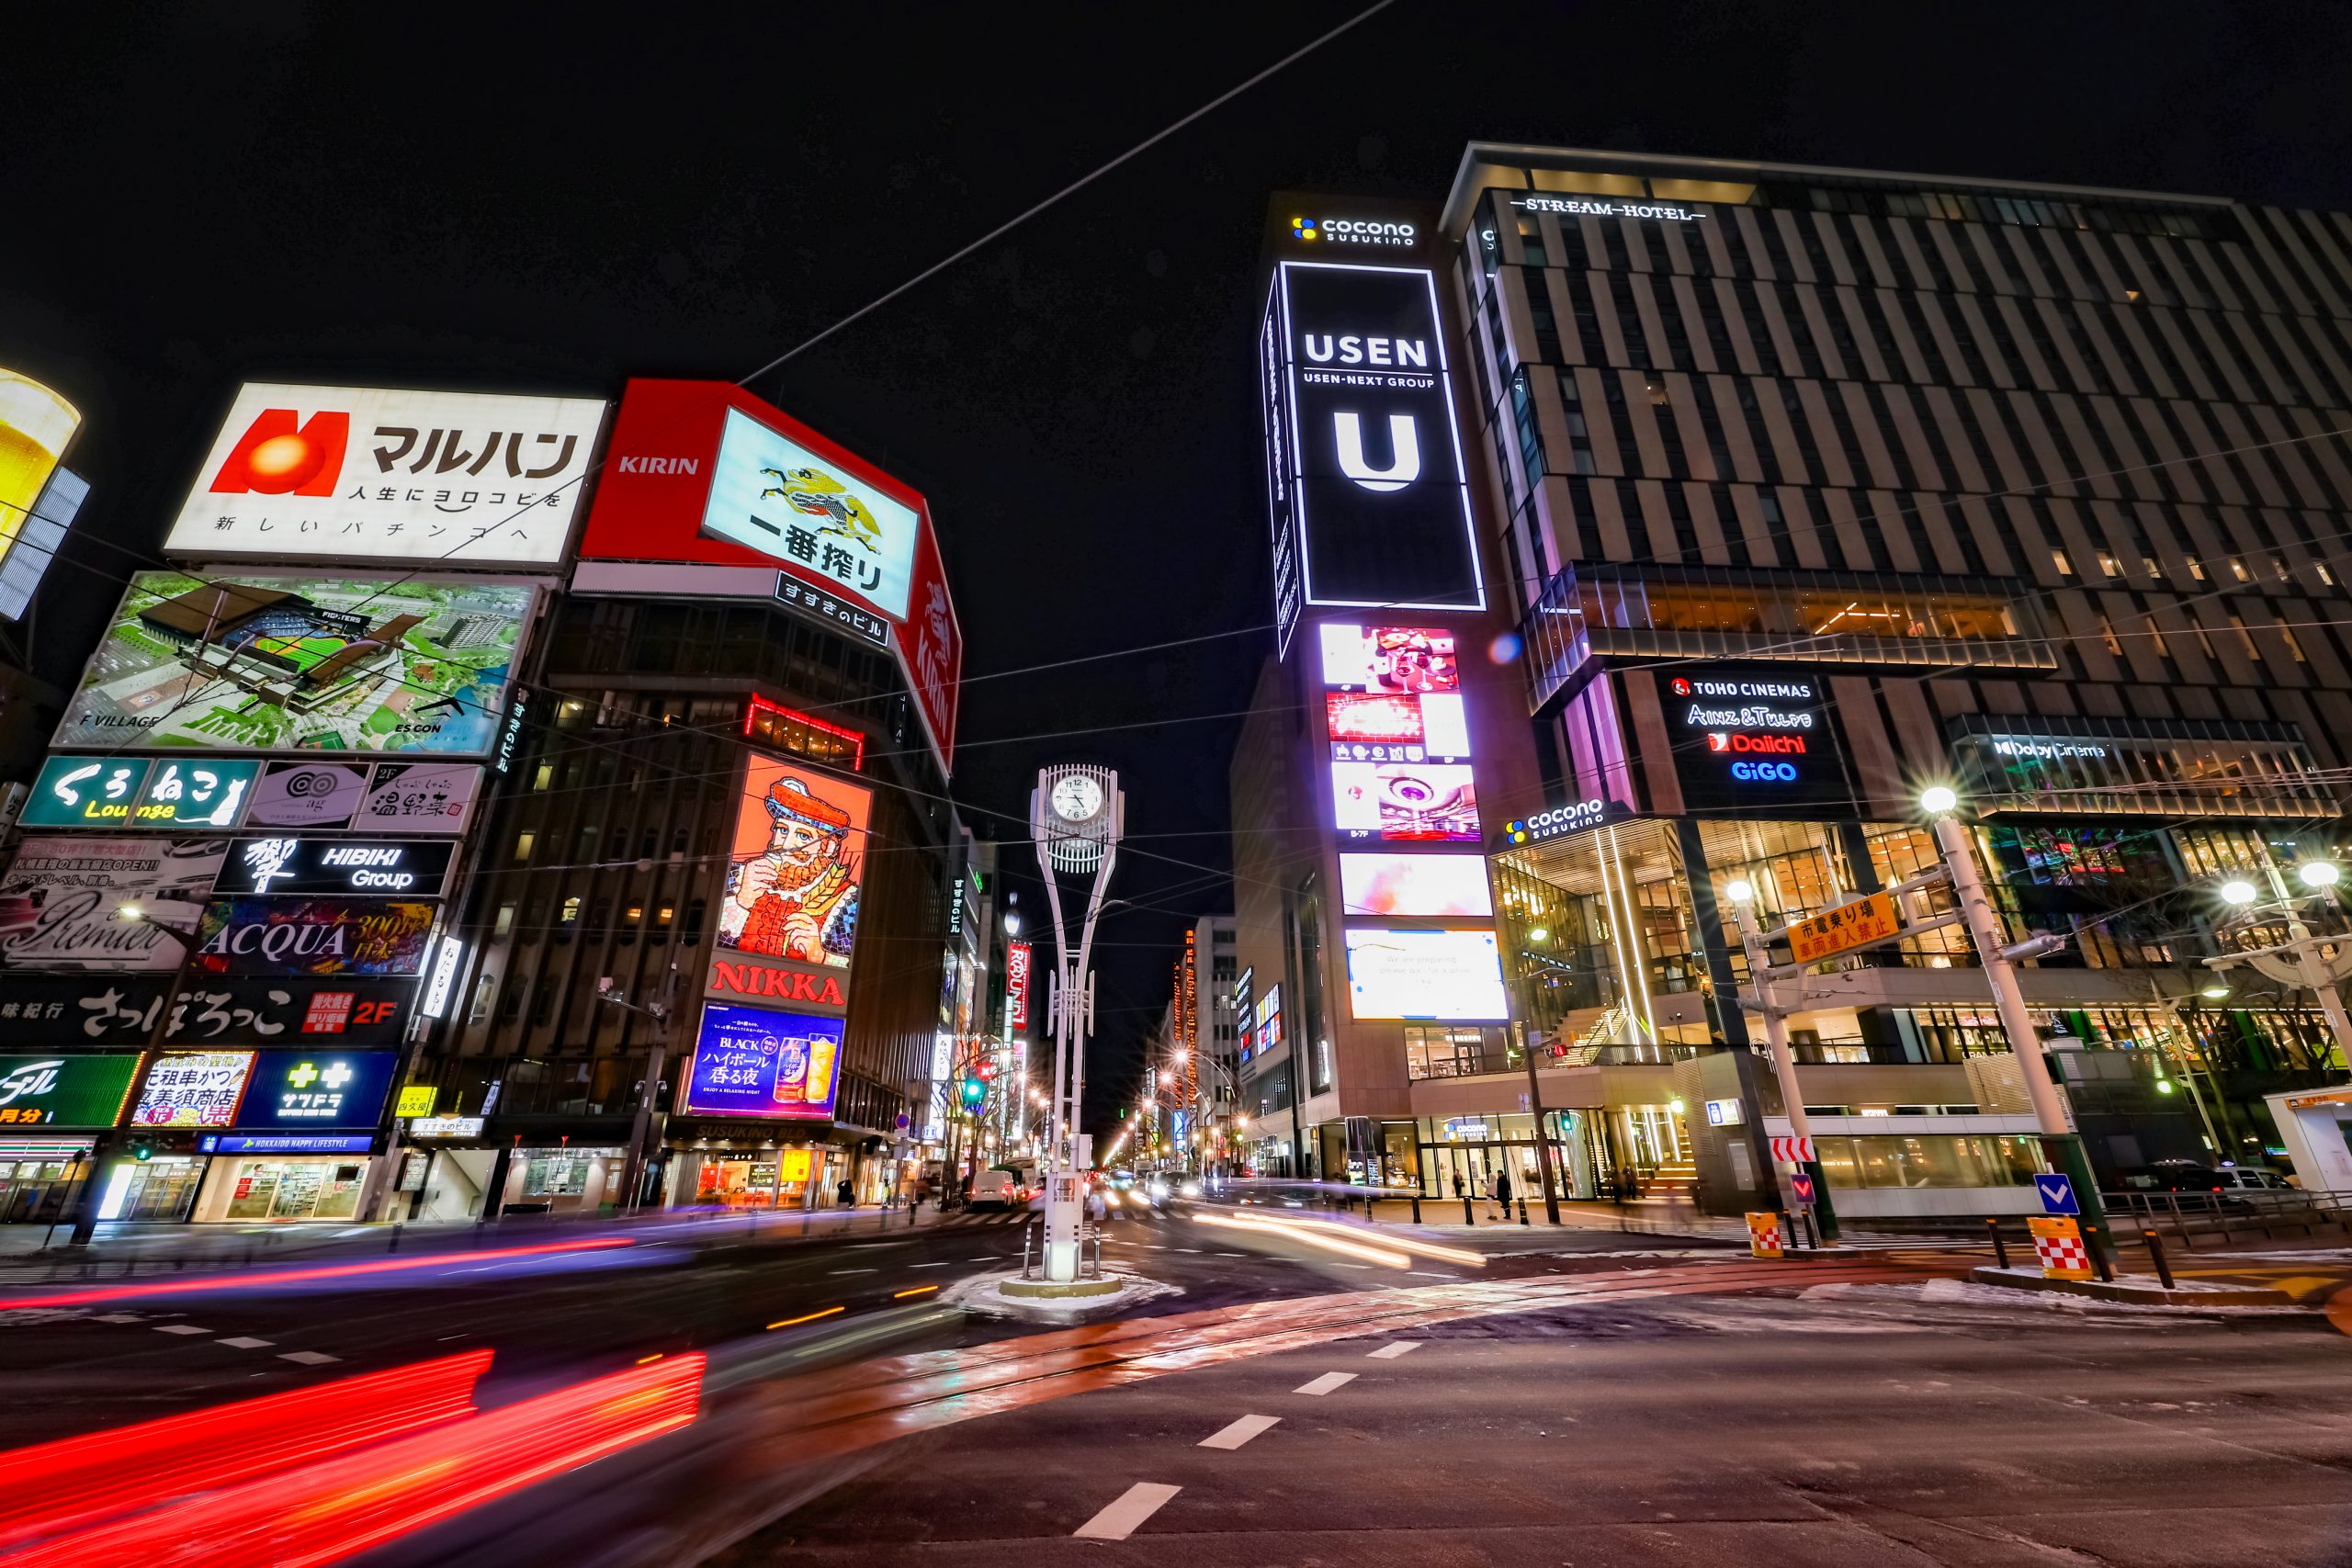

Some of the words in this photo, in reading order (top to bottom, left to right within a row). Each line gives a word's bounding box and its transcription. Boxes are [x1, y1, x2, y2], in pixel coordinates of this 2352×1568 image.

[1526, 197, 1613, 216] STREAM
[1623, 205, 1692, 221] HOTEL
[1304, 333, 1429, 367] USEN
[1303, 372, 1384, 387] USEN-NEXT
[1386, 377, 1435, 389] GROUP
[372, 425, 579, 479] マルハン
[618, 456, 699, 476] KIRIN
[348, 484, 562, 508] 人生にヨロコビを
[213, 514, 529, 542] 新しいパチンコへ
[749, 513, 882, 592] 一番搾り
[785, 583, 883, 637] すすきのビル
[1693, 681, 1738, 696] TOHO
[1740, 682, 1812, 699] CINEMAS
[80, 715, 93, 728] F
[95, 715, 160, 728] VILLAGE
[413, 725, 442, 734] CON
[1732, 733, 1807, 754] Daiichi
[378, 768, 397, 780] 2F
[1731, 761, 1798, 782] GiGO
[54, 763, 219, 807] くろねこ
[85, 800, 176, 819] Lounge
[371, 791, 448, 816] 温野菜
[322, 848, 402, 866] HIBIKI
[351, 869, 413, 889] Group
[950, 878, 965, 933] すすきのビル
[1801, 900, 1875, 940] 市電乗り場
[198, 923, 345, 962] ACQUA
[1798, 917, 1890, 960] 車両進入禁止
[710, 960, 846, 1005] NIKKA
[1, 1002, 64, 1020] 味紀行
[78, 987, 291, 1038] さっぽろっこ
[352, 1001, 396, 1024] 2F
[719, 1037, 760, 1051] BLACK
[702, 1052, 771, 1068] ハイボール
[148, 1068, 231, 1088] 元祖串かつ
[709, 1066, 760, 1086] 香る夜
[282, 1093, 343, 1109] サツドラ
[399, 1102, 427, 1111] 四文屋
[424, 1122, 472, 1131] すすきのビル
[696, 1125, 774, 1138] SUSUKINO
[777, 1127, 808, 1139] BLD.
[255, 1138, 289, 1148] HOKKAIDO
[291, 1138, 312, 1148] HAPPY
[313, 1138, 347, 1148] LIFESTYLE
